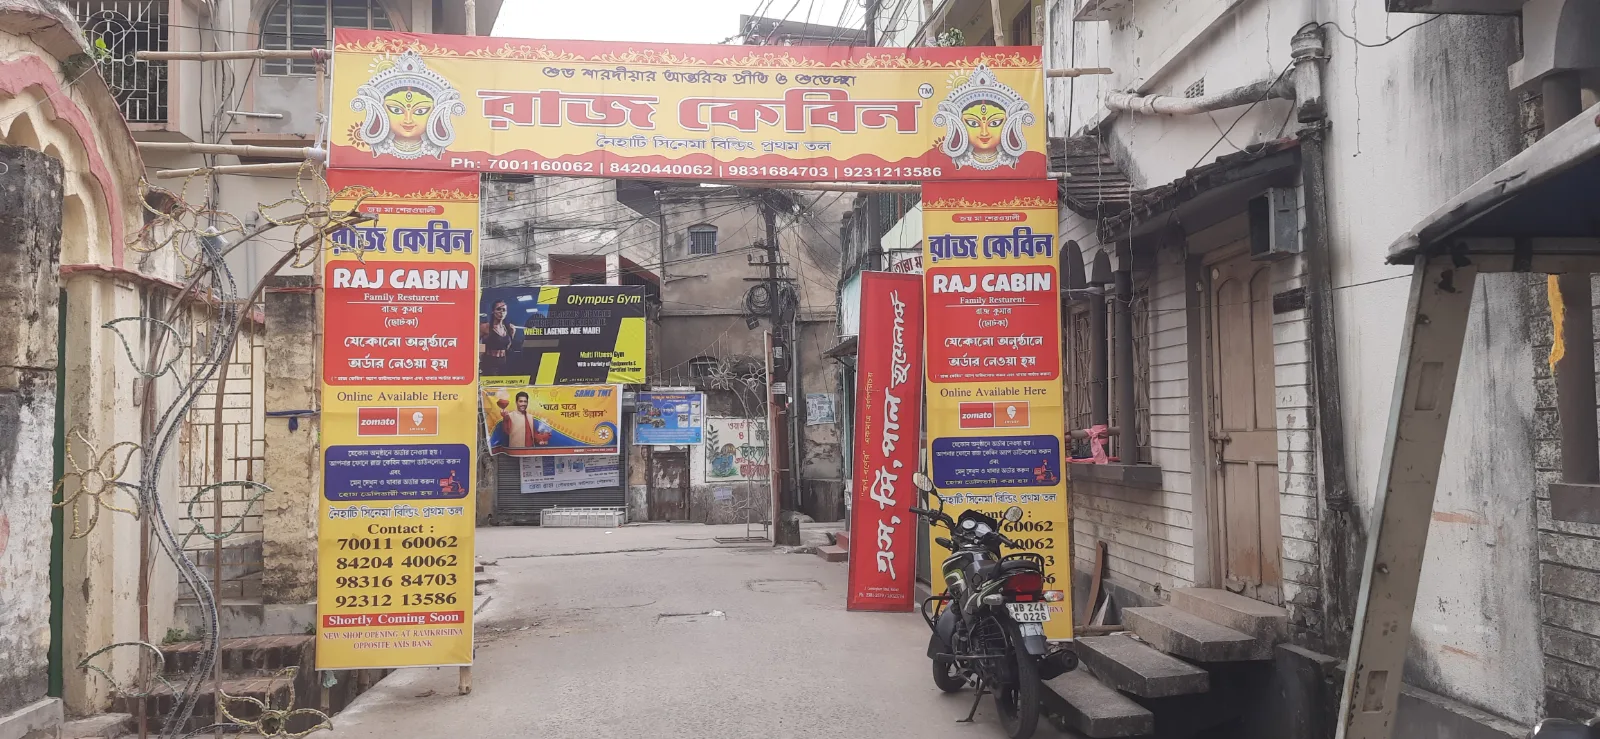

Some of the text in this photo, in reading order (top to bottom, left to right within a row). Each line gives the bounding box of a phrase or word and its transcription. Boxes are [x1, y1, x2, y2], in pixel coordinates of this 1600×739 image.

[542, 65, 857, 88] শুভ শারদীয়ার আন্তরিক প্রীতি ও শুভেচ্ছা
[475, 87, 923, 135] রাজ কেবিন
[595, 133, 649, 150] নৈহাটি
[653, 135, 707, 151] সিনেমা
[760, 140, 799, 153] প্রথম
[804, 141, 832, 152] তল
[450, 157, 942, 178] Ph: 7001160062 8420440062 9831684703 9231213586
[392, 220, 474, 255] কেবিন
[928, 226, 1054, 262] রাজ কেবিন
[914, 255, 923, 268] ম
[333, 268, 469, 290] RAJ CABIN
[933, 272, 1051, 294] RAJ CABIN
[364, 292, 440, 303] Family Resturent
[567, 293, 641, 306] Olympus Gym
[960, 296, 1026, 305] Family Resturent
[381, 304, 423, 315] রাজ কুমার
[975, 307, 1012, 316] রাজ কুমার
[523, 327, 543, 336] WHERE
[570, 327, 581, 335] ARE
[344, 335, 458, 352] যেকোনো অনুষ্ঠানে
[944, 332, 1043, 350] যেকোনো অনুষ্ঠানে
[348, 353, 448, 370] অর্ডার নেওয়া হয়
[948, 352, 1036, 367] অর্ডার নেওয়া হয়
[337, 390, 459, 401] Online Available Here
[574, 389, 613, 398] SRMB TMT
[940, 386, 1047, 398] Online Available Here
[360, 417, 396, 426] zomato
[961, 410, 992, 420] zomato
[965, 491, 993, 505] সিনেমা
[1020, 492, 1041, 504] প্রথম
[1043, 493, 1057, 503] তল
[328, 506, 358, 520] নৈহাটি
[360, 505, 391, 519] সিনেমা
[423, 506, 446, 519] প্রথম
[448, 506, 464, 517] তল
[367, 523, 424, 534] Contact
[1003, 520, 1054, 532] 60062
[337, 535, 458, 551] 70011 60062
[336, 554, 458, 570] 84204 40062
[335, 573, 457, 589] 98316 84703
[335, 592, 457, 608] 92312 13586
[1013, 603, 1025, 613] WB
[1028, 603, 1045, 612] 24A
[328, 612, 459, 626] Shortly Coming Soon
[1015, 612, 1046, 622] C 0226
[342, 631, 363, 639] SHOP
[364, 630, 398, 639] OPENING
[413, 628, 463, 637] RAMKRISHNA
[353, 640, 433, 649] OPPOSITE AXIS BANK
